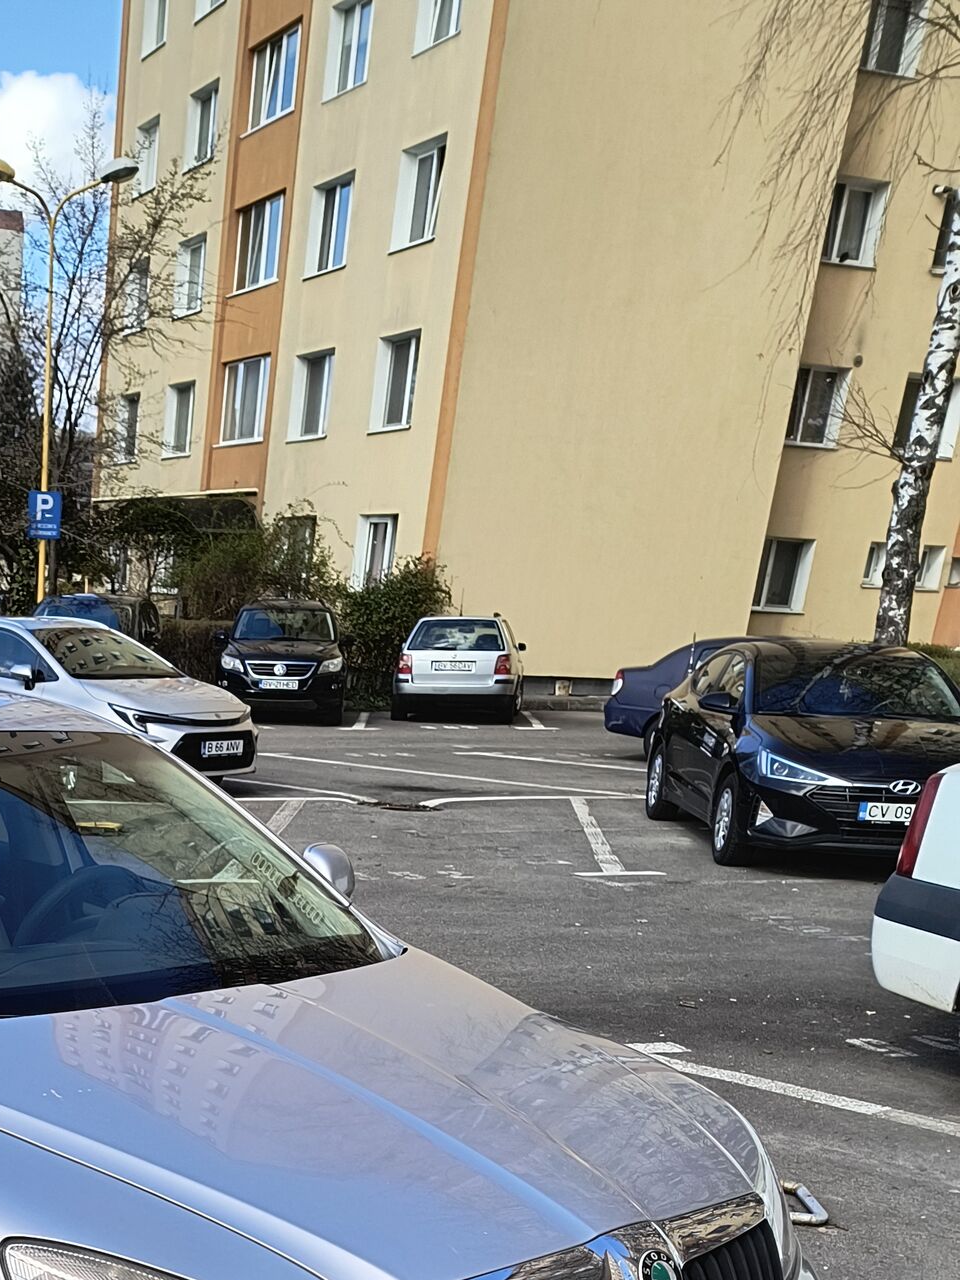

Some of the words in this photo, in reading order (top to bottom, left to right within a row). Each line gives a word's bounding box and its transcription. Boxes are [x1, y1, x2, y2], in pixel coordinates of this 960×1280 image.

[36, 494, 54, 520] P
[208, 742, 214, 753] B
[215, 742, 224, 752] 66
[226, 741, 240, 752] ANV
[869, 805, 890, 818] CV
[895, 806, 912, 819] 09
